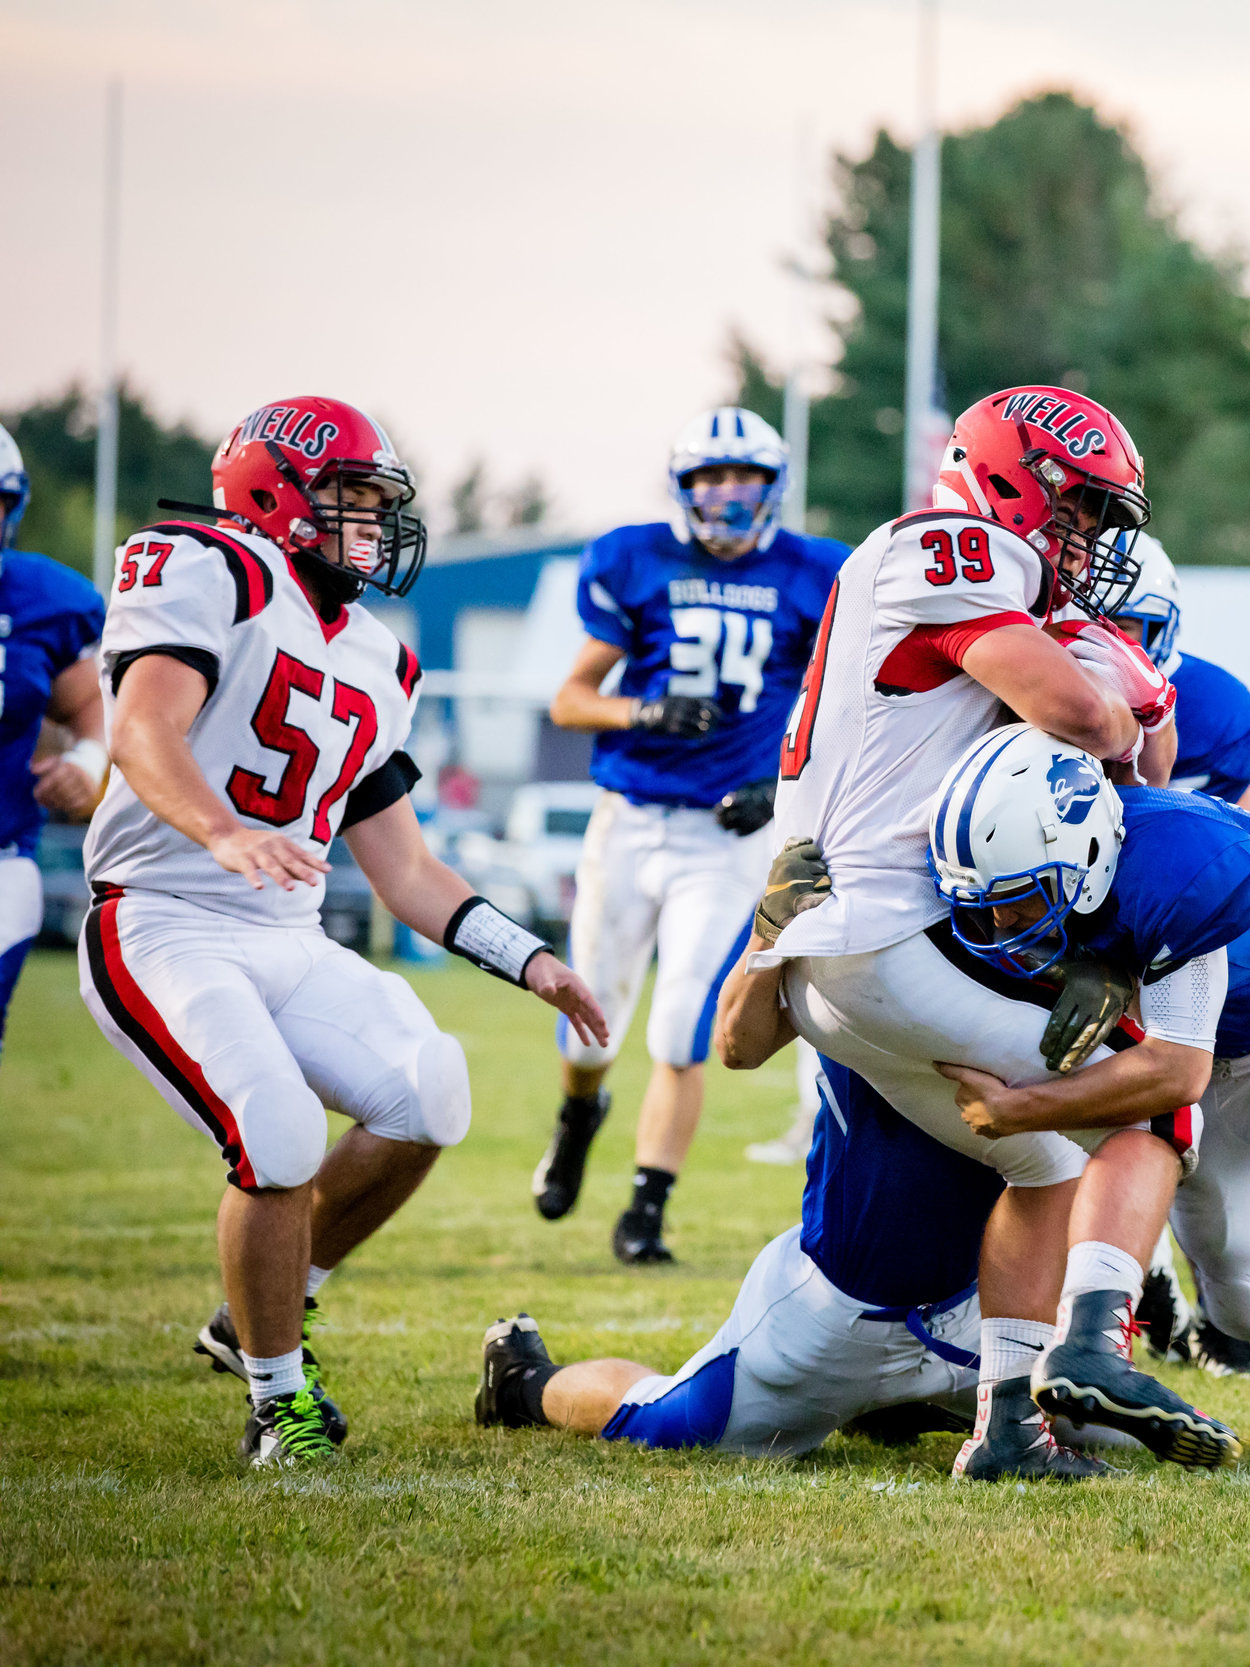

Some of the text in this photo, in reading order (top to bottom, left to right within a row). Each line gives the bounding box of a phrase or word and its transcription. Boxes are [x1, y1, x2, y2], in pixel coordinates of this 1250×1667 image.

[239, 406, 339, 459] WELLS
[1001, 393, 1106, 458] WELLS
[118, 541, 174, 593] 57
[920, 526, 996, 587] 39
[667, 607, 774, 713] 34
[226, 647, 378, 846] 57
